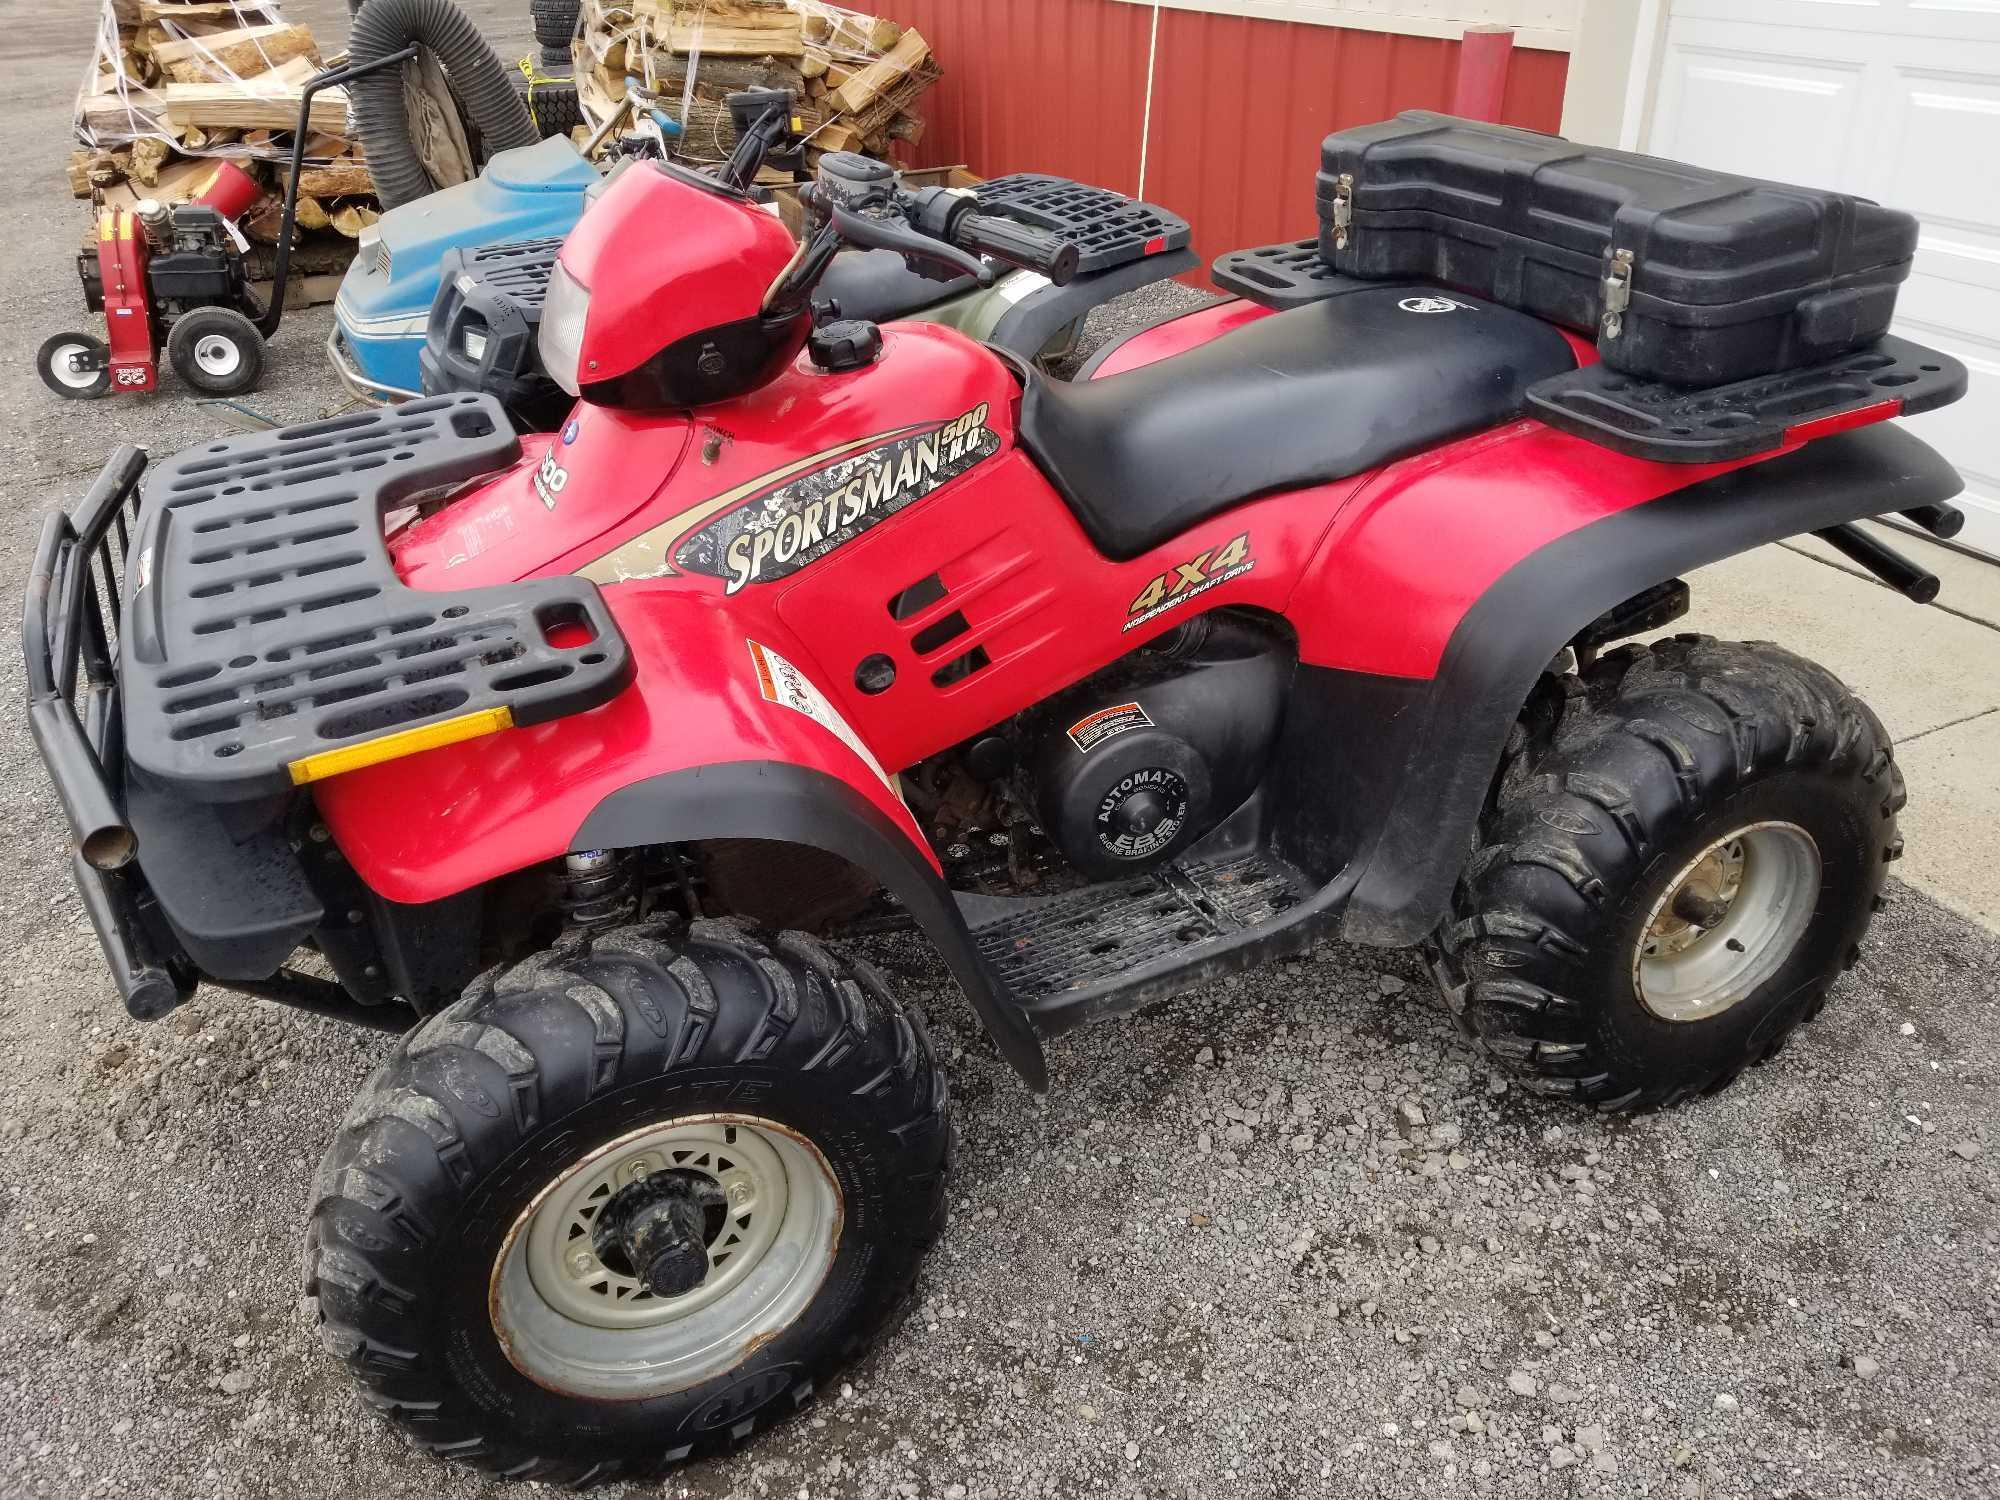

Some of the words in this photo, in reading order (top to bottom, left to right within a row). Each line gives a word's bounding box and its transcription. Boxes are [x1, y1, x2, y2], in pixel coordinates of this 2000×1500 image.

[948, 427, 983, 463] H.O.
[725, 432, 942, 595] SPORTSMAN
[941, 401, 989, 444] 500
[1122, 594, 1189, 633] INDEPENDENT
[1188, 575, 1224, 598] SHAFT
[1223, 560, 1256, 581] DRIVE
[1127, 532, 1250, 615] 4X4
[1097, 770, 1185, 823] AUTOMAT
[1113, 817, 1174, 851] EBS
